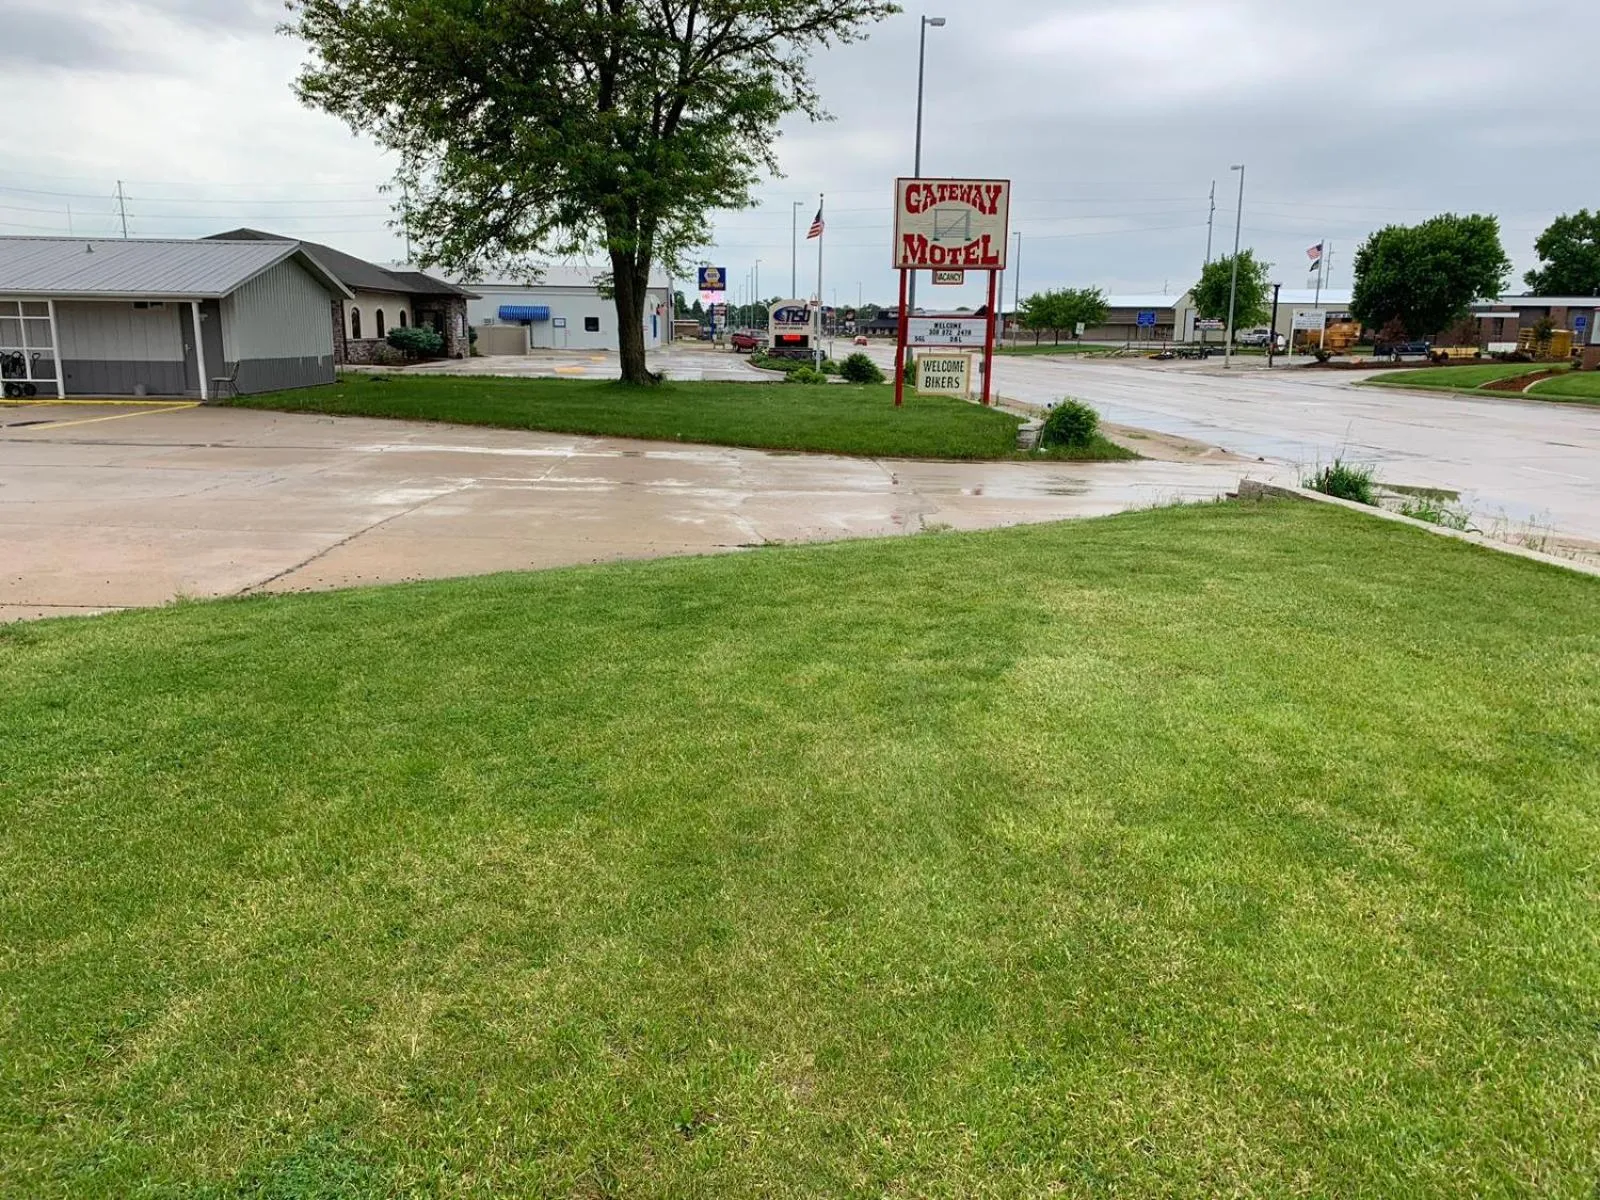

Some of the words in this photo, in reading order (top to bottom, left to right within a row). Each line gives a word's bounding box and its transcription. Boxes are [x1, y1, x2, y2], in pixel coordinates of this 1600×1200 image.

[905, 183, 1002, 215] GATEWAY
[902, 234, 1000, 265] MOTEL
[936, 272, 961, 282] VACANCY
[923, 360, 965, 373] WELCOME
[925, 376, 960, 389] BIKERS
